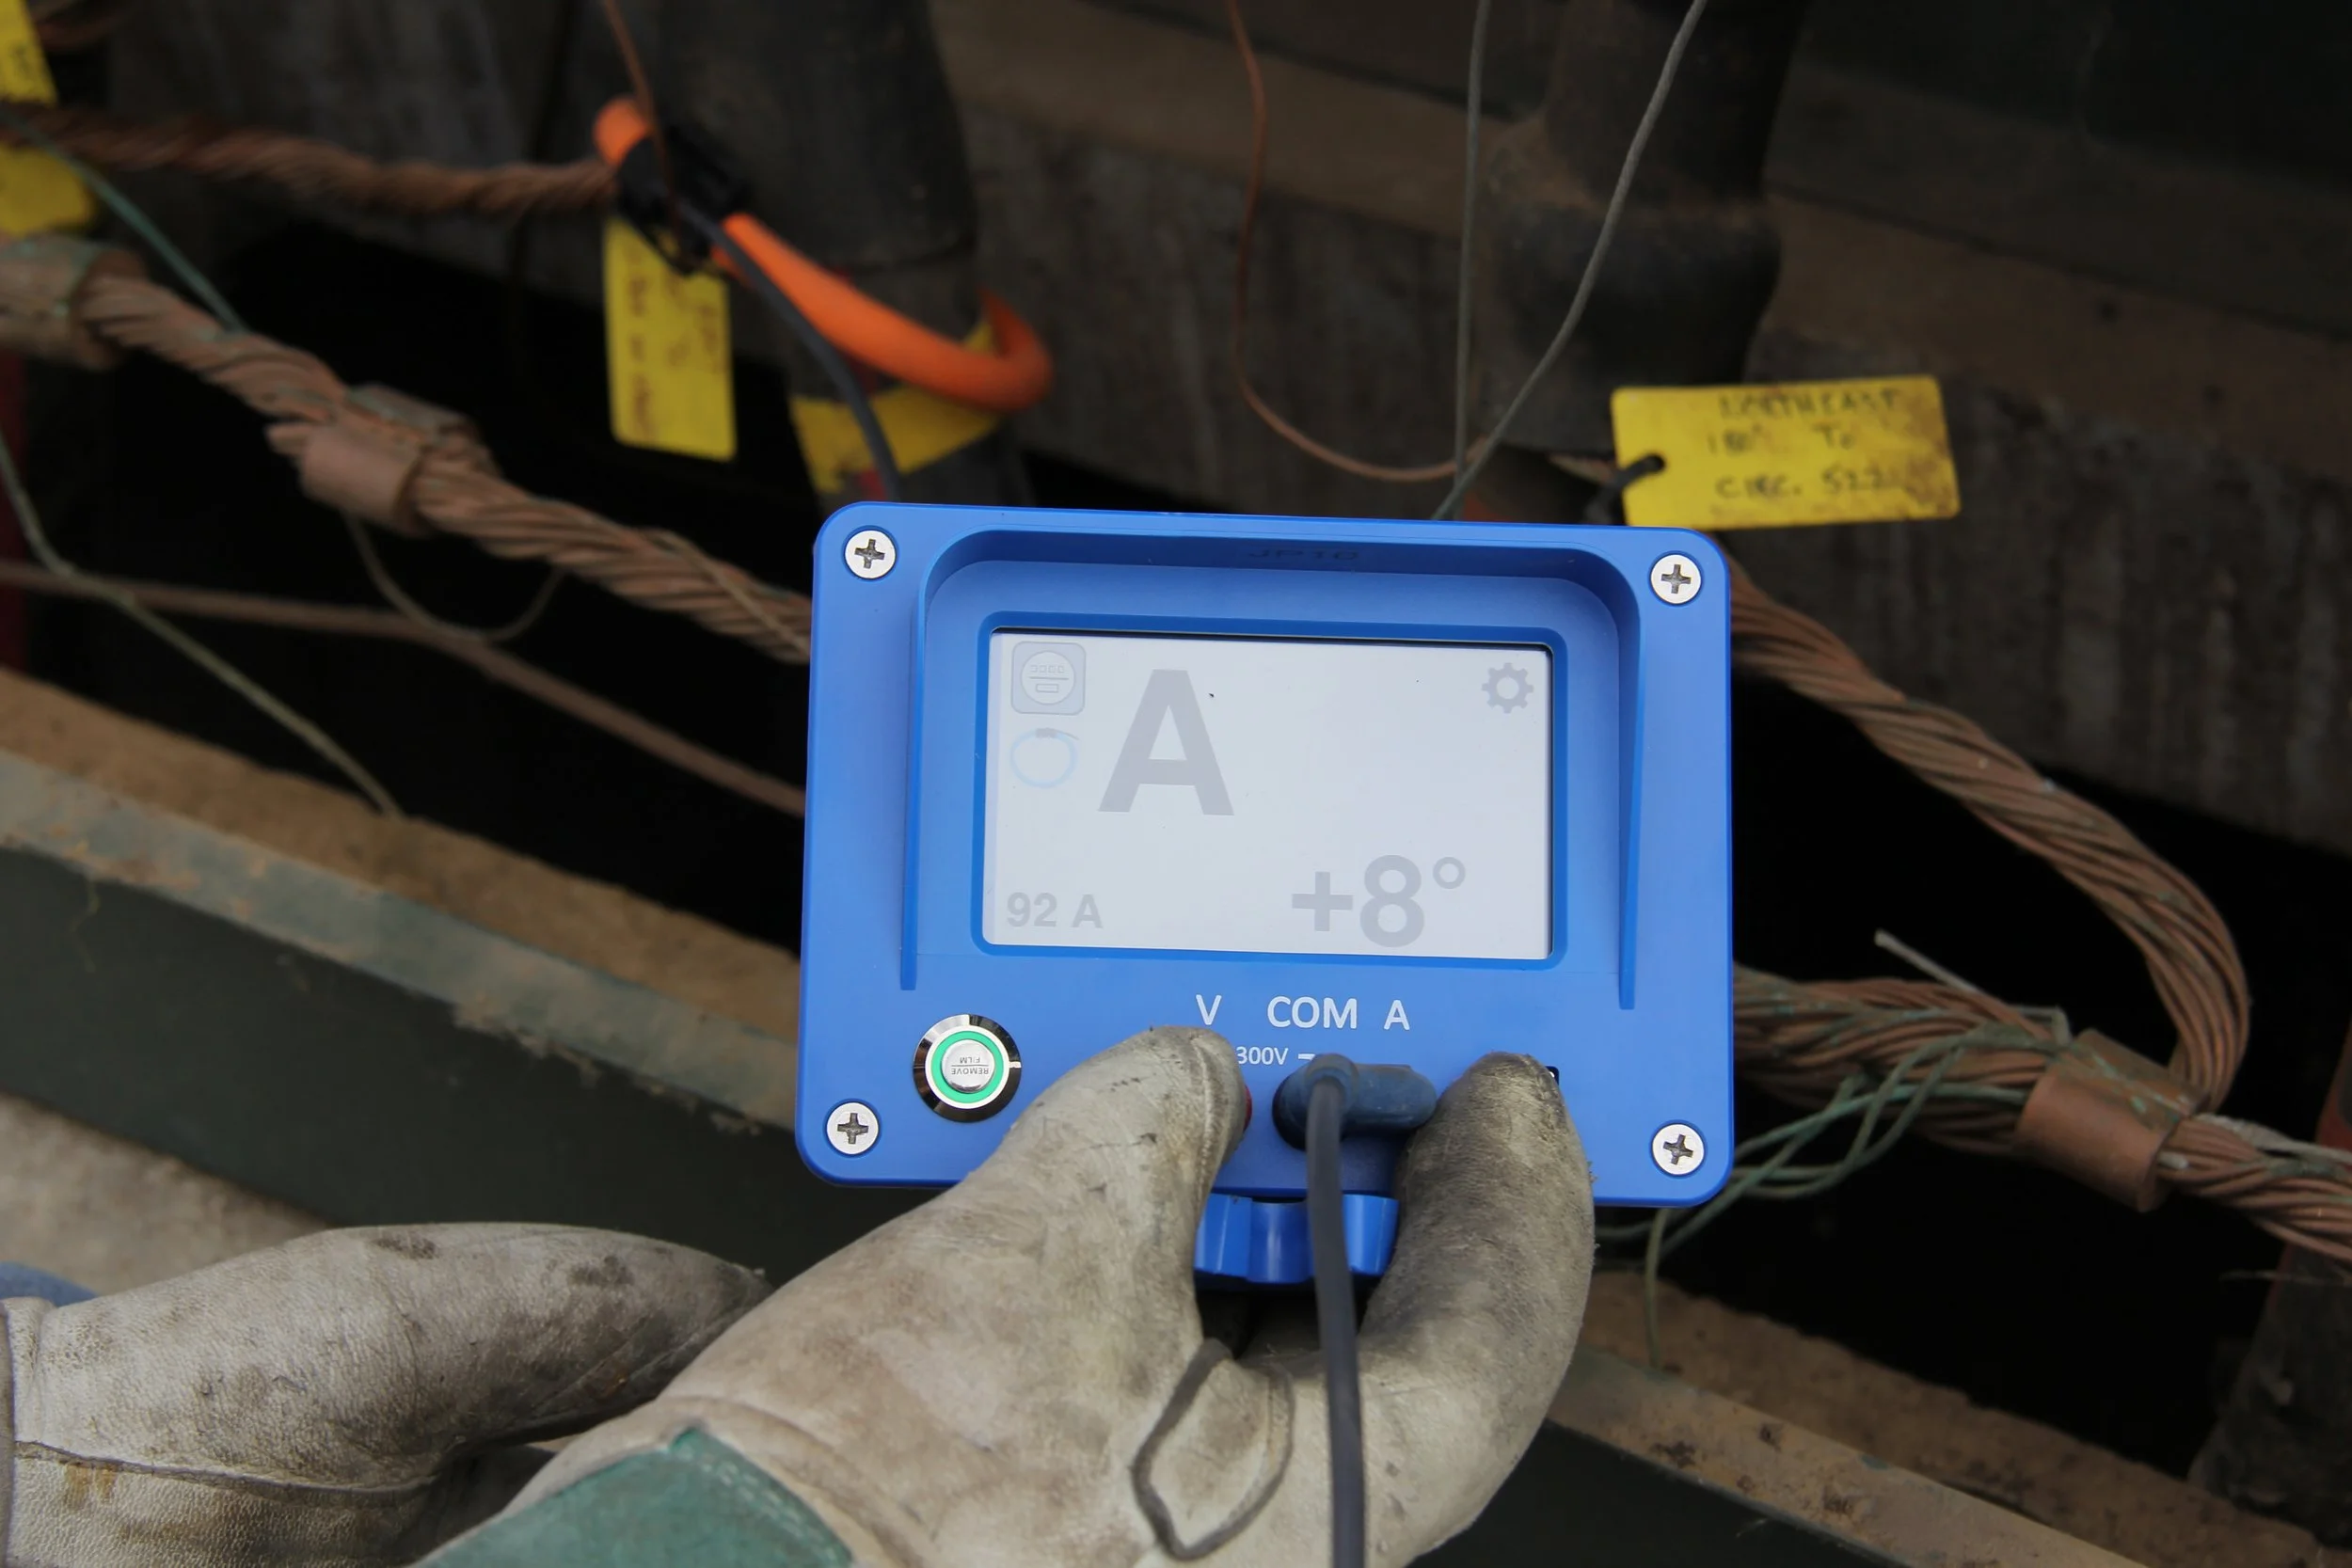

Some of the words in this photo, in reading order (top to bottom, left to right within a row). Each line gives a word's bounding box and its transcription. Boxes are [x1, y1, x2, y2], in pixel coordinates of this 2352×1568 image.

[1097, 668, 1235, 816] A
[1006, 891, 1057, 928] 92
[1071, 894, 1104, 929] A
[1291, 853, 1467, 948] +8°
[1195, 994, 1222, 1026] V
[1266, 995, 1358, 1029] COM
[1383, 999, 1410, 1031] A
[1236, 1045, 1289, 1066] 300V
